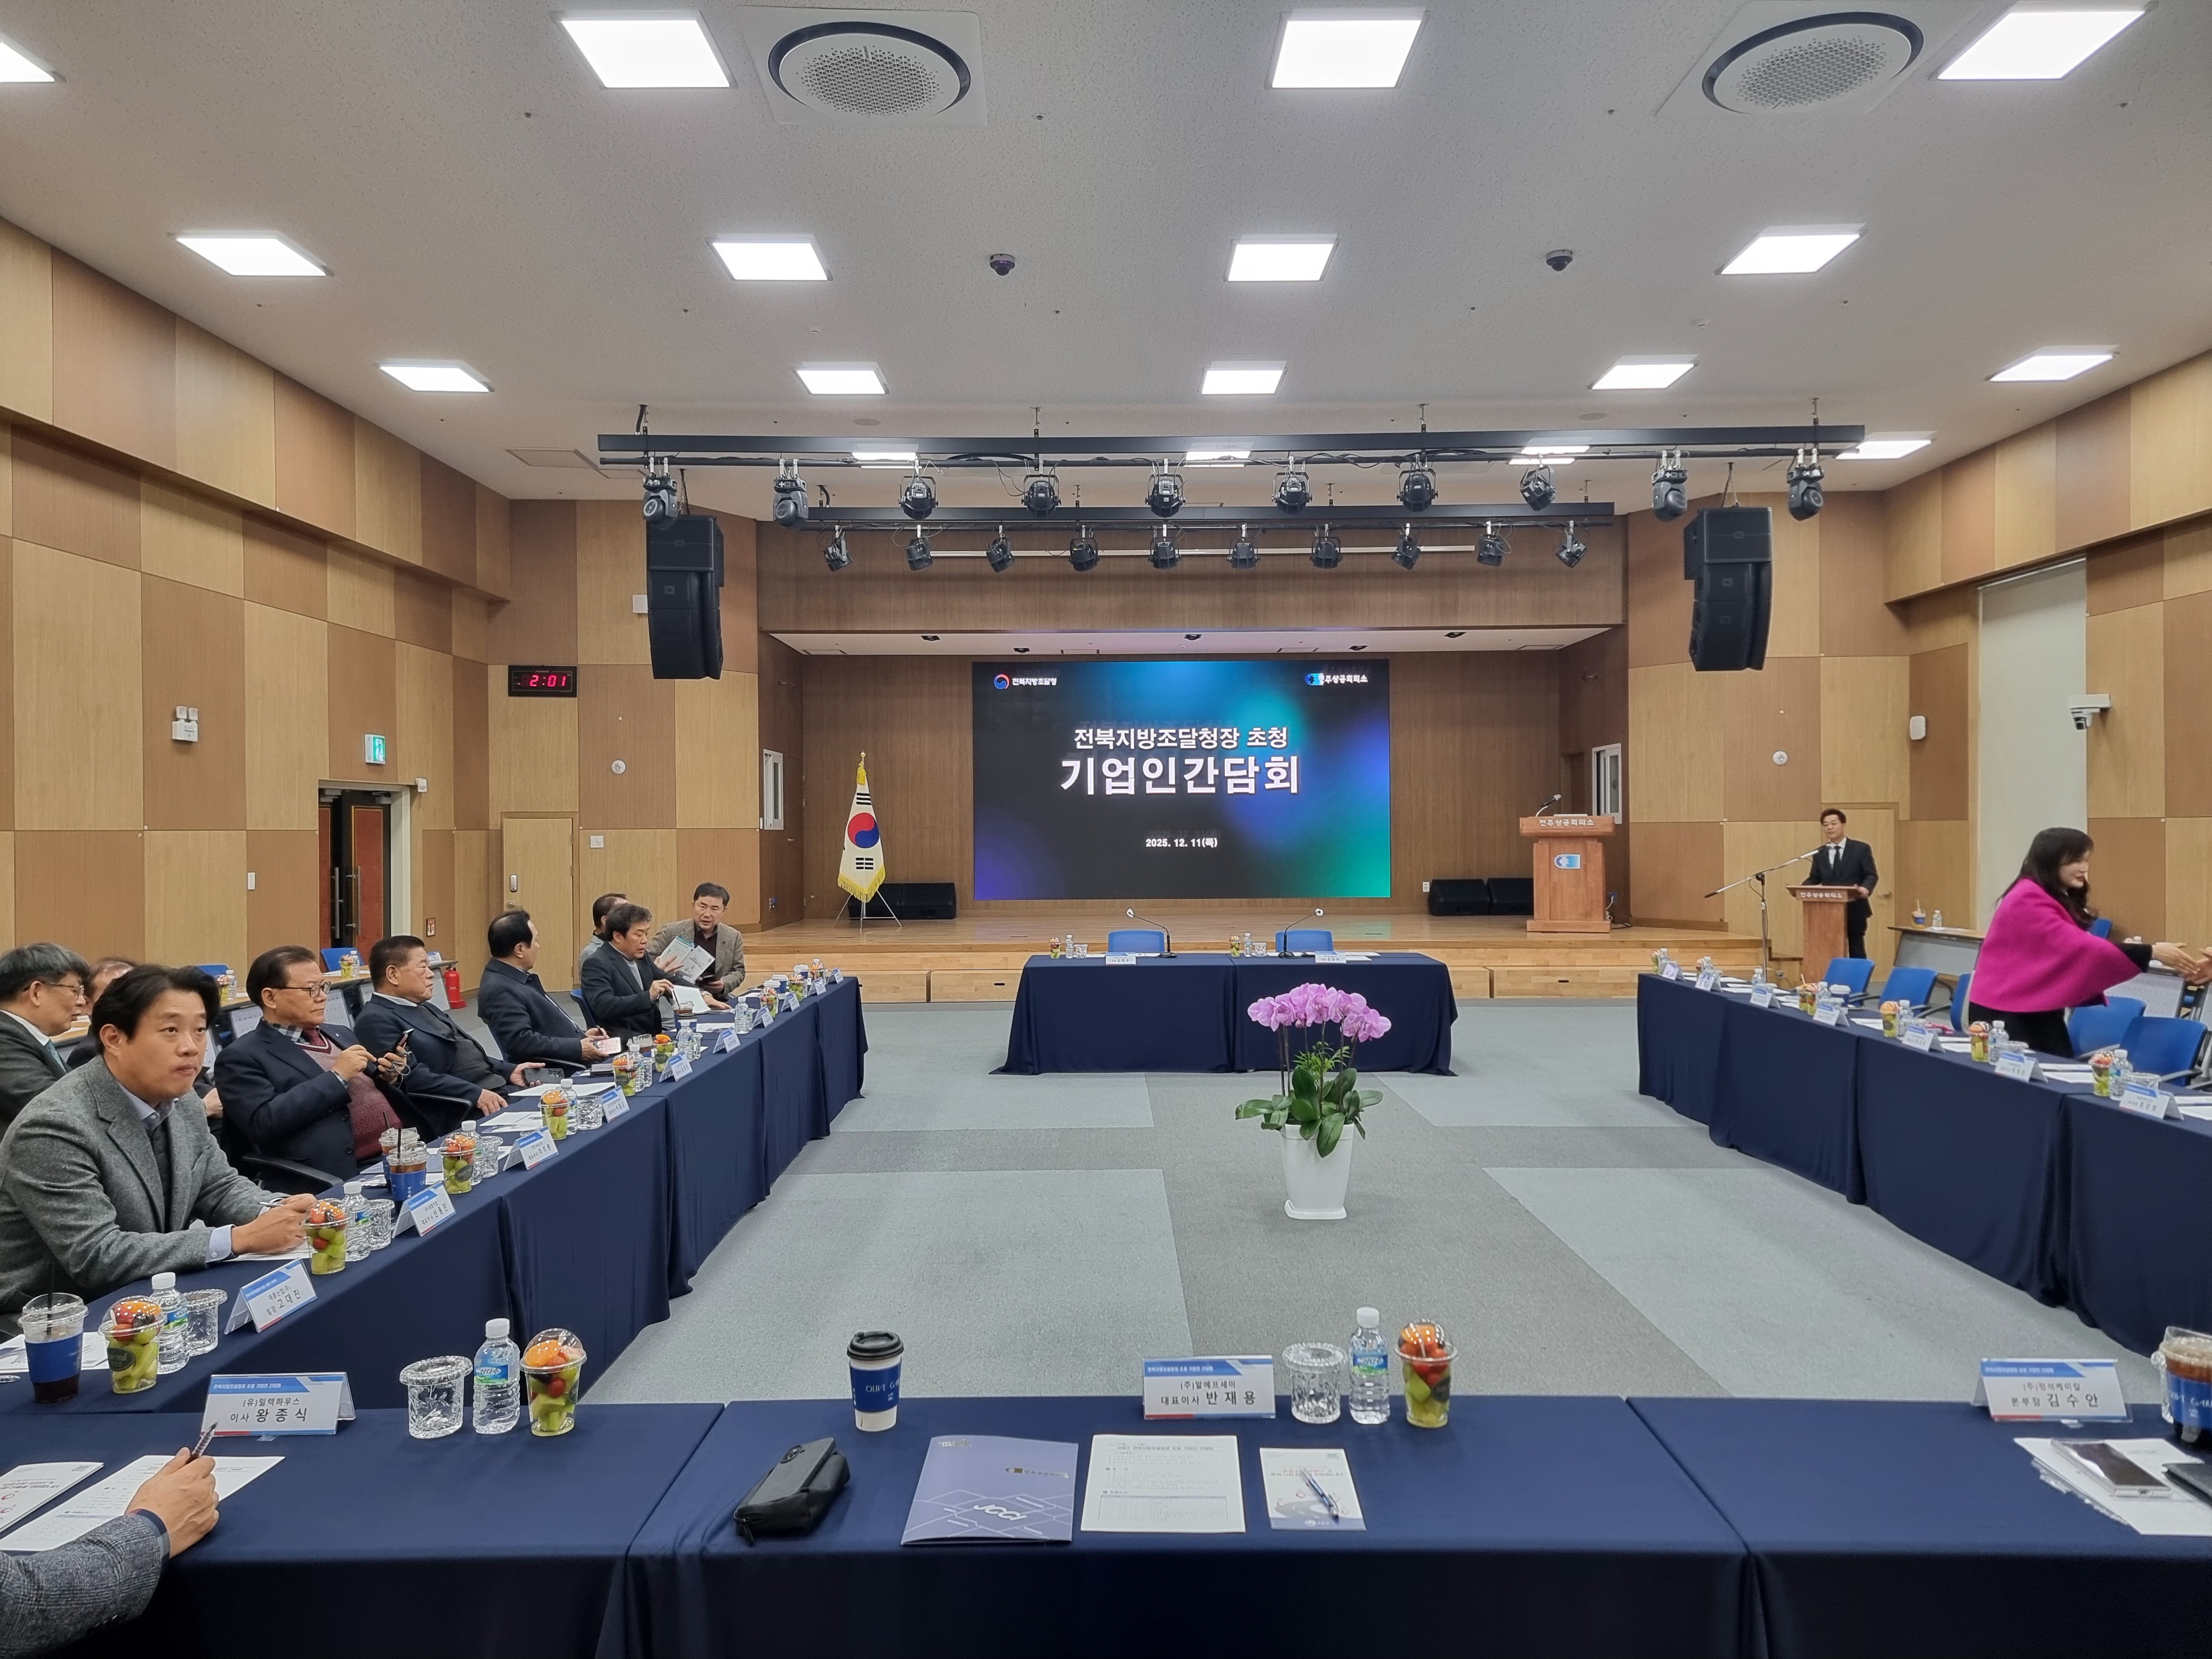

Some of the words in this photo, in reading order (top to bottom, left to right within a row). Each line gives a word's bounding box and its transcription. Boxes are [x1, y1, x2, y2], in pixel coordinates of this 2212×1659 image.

[530, 675, 566, 687] 2:01
[1012, 677, 1057, 686] 전북지방조달청
[1074, 727, 1240, 750] 전북지방조달청장
[1246, 727, 1288, 749] 초청
[1061, 755, 1298, 795] 기업인간담회
[1146, 838, 1171, 847] 2025.
[1173, 838, 1188, 847] 12.
[1190, 838, 1218, 848] 11(목)
[1180, 1381, 1235, 1390] (주)알에프세미
[243, 1397, 300, 1407] (유)일렉하우스
[1161, 1396, 1199, 1405] 대표이사
[231, 1413, 249, 1422] 이사
[973, 1504, 1027, 1521] JCCI
